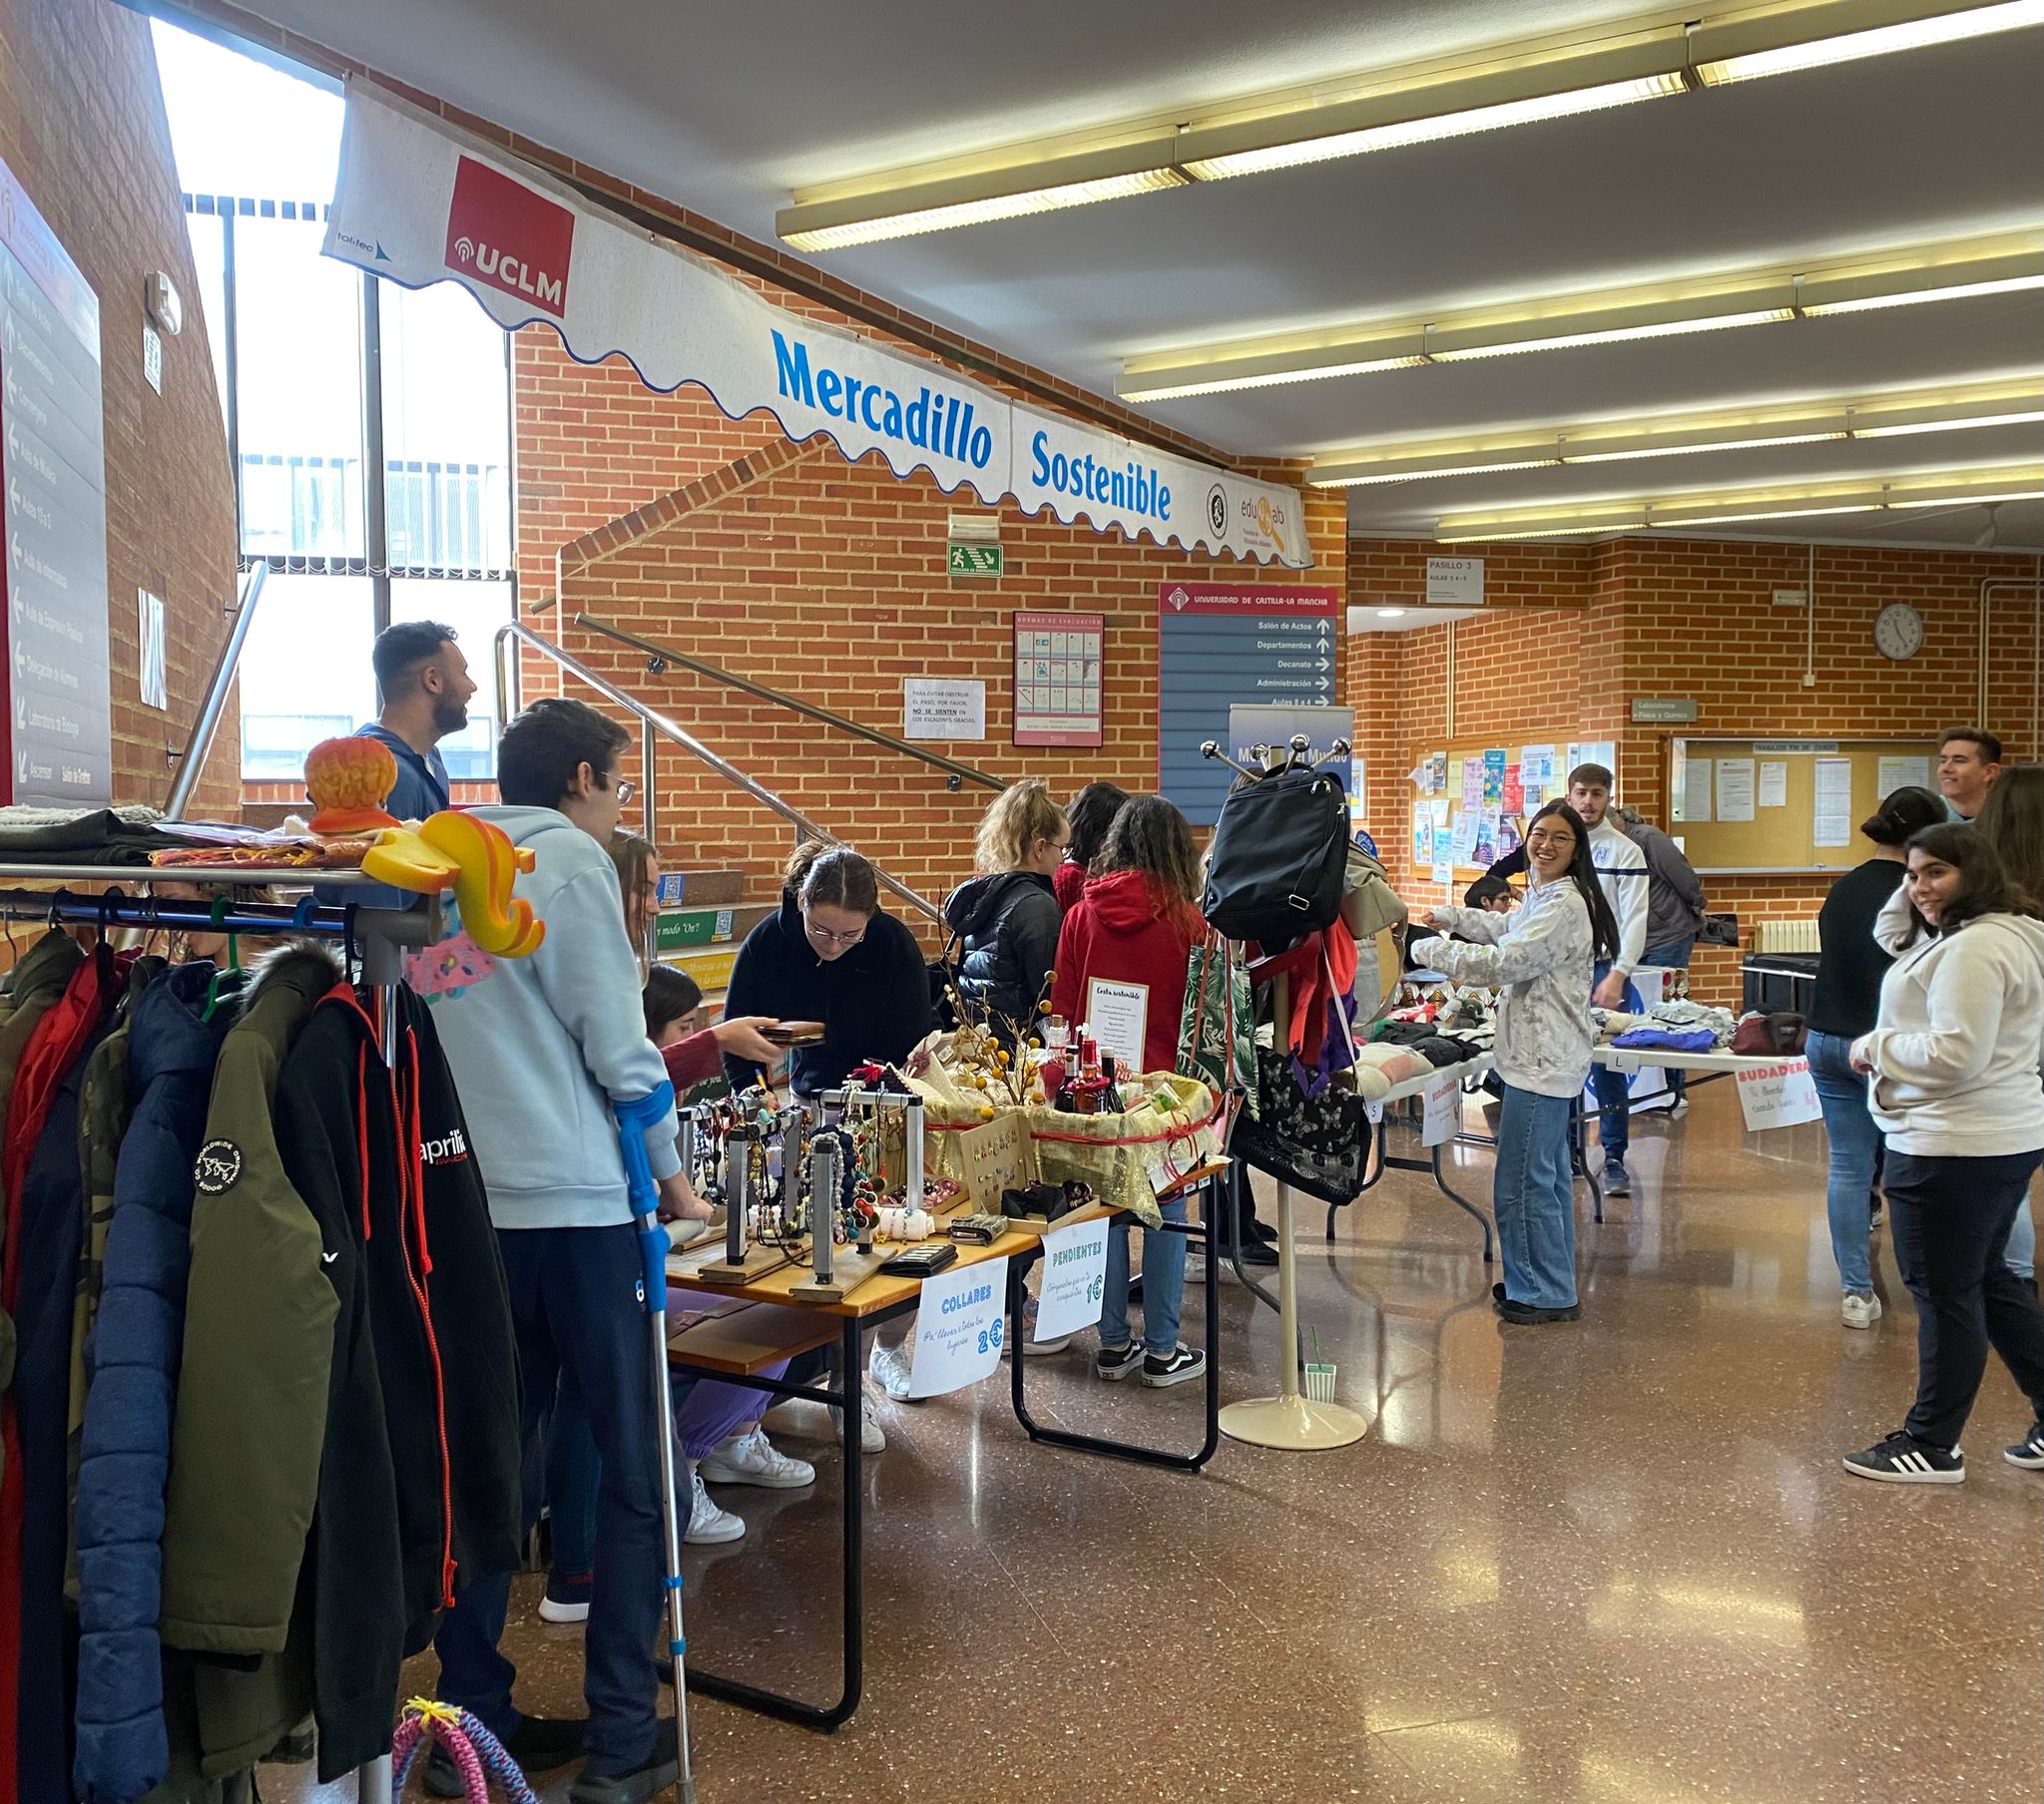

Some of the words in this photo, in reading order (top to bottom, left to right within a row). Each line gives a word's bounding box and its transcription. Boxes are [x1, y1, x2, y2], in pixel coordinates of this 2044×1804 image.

[475, 243, 562, 306] UCLM
[769, 327, 992, 469] Mercadillo
[1031, 430, 1171, 521] Sostenible
[1429, 561, 1462, 570] PASILLO
[1195, 595, 1239, 605] UNIVERSIDAD
[1297, 598, 1327, 607] MANCHA
[1259, 622, 1278, 631] Salón
[1290, 622, 1312, 632] Actos
[1258, 641, 1312, 651] Departamentos
[1278, 660, 1312, 670] Decanato
[1257, 678, 1311, 688] Administración
[1096, 986, 1113, 996] Cesta
[1113, 990, 1140, 1000] sostenible
[1616, 1057, 1623, 1067] L
[1371, 1105, 1376, 1118] S
[197, 1140, 234, 1164] WORLDWIDE
[226, 1149, 241, 1184] ORIGINAL
[1052, 1241, 1102, 1268] PENDIENTES
[941, 1284, 992, 1315] COLLARES
